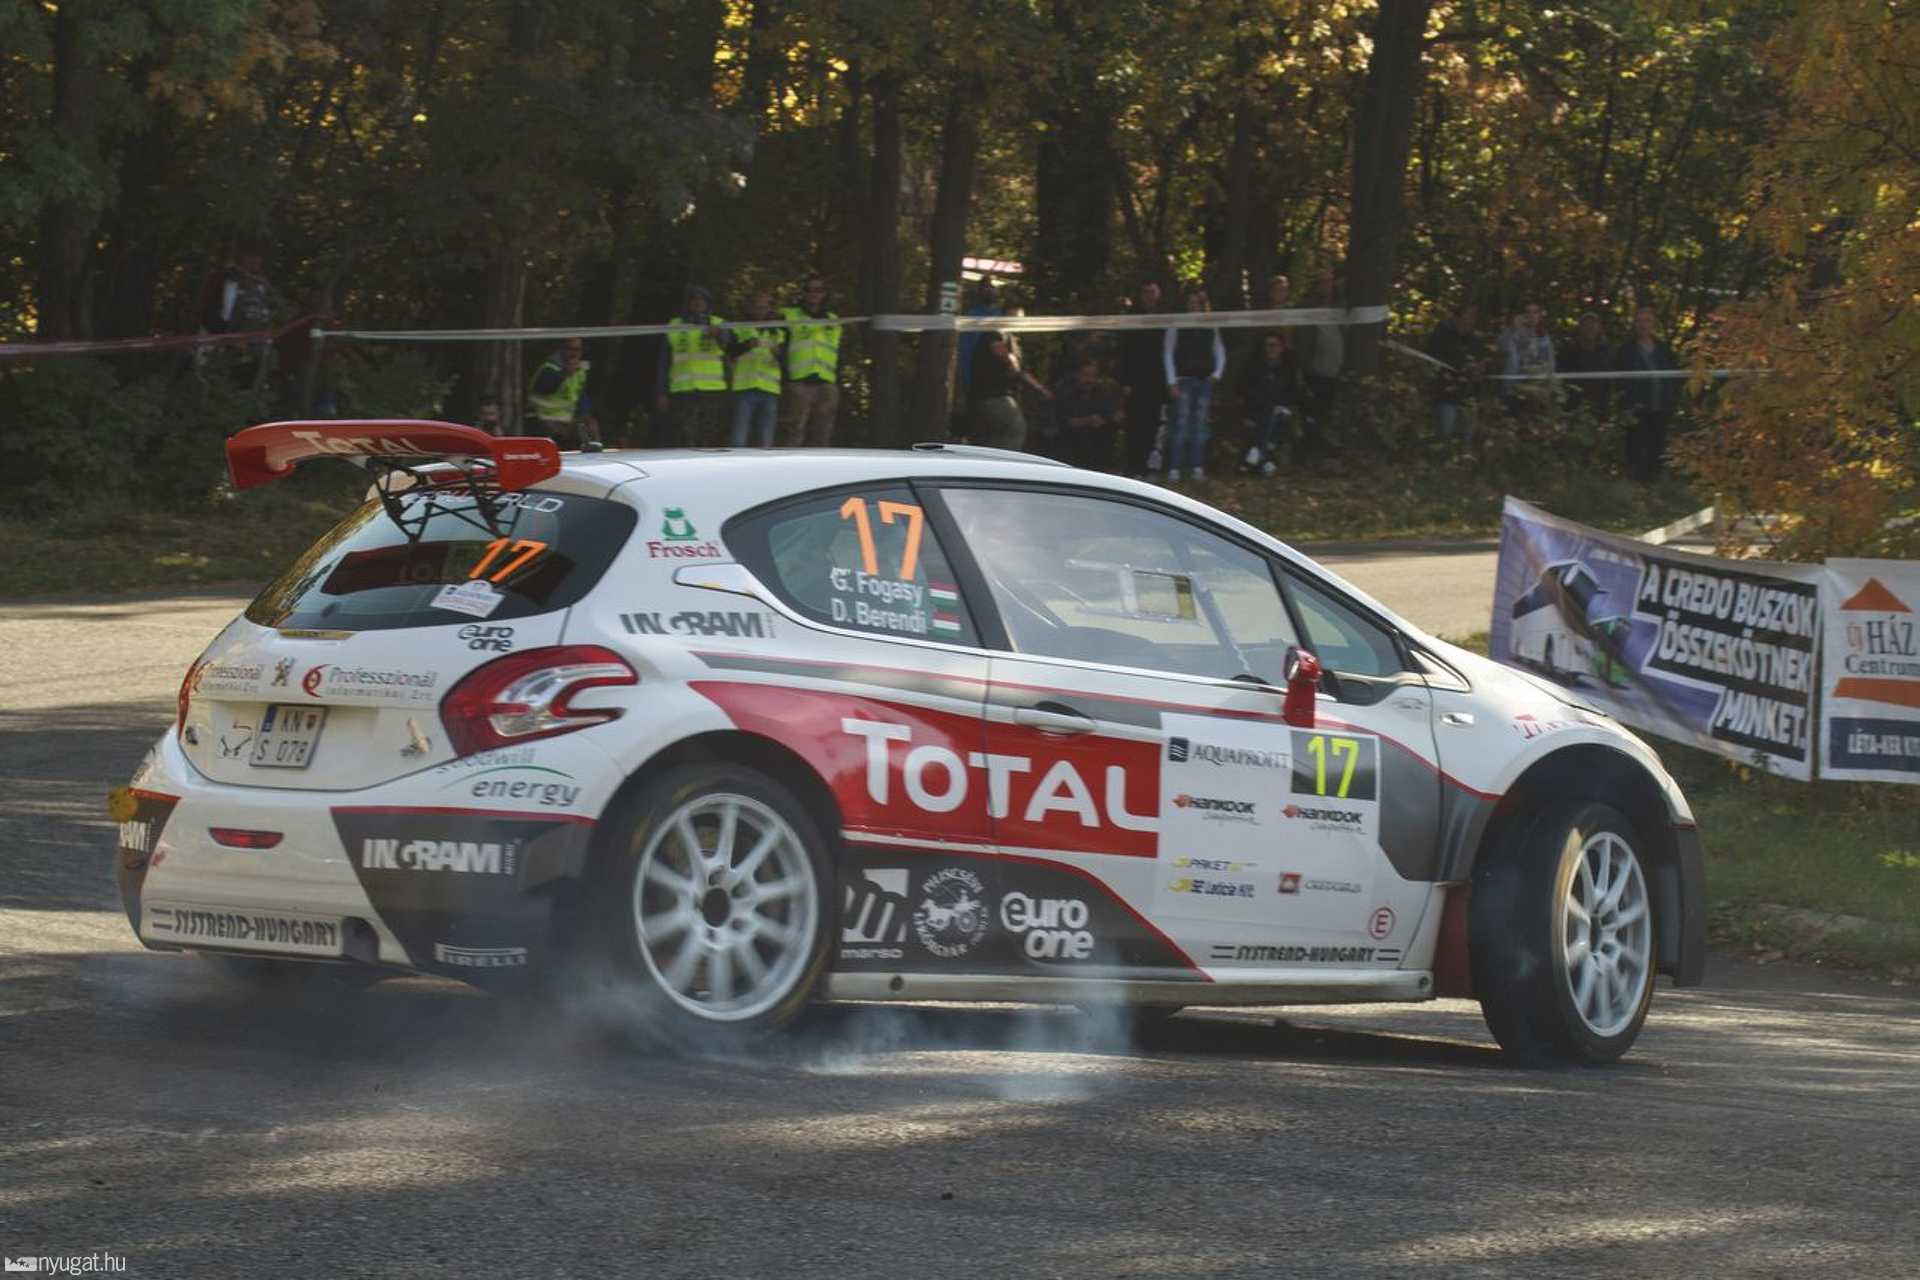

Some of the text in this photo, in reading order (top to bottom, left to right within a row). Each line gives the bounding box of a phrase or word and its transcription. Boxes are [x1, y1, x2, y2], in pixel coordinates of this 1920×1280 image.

[646, 541, 721, 558] Frosch
[840, 496, 925, 582] 17
[468, 535, 548, 583] 17
[829, 567, 924, 608] G. Fogasy
[1640, 563, 1815, 637] A CREDO BUSZOK
[457, 624, 514, 640] euro
[619, 611, 765, 638] INGRAM
[831, 598, 928, 634] D. Berendi
[469, 639, 512, 652] one
[1658, 611, 1813, 694] ÖSSZEKÖTNEK
[1866, 615, 1916, 656] HÁZ
[279, 711, 300, 733] KN
[1716, 689, 1806, 746] MINKET.
[257, 741, 309, 762] S 078
[1307, 735, 1360, 799] 17
[472, 780, 582, 807] energy
[841, 718, 1159, 832] TOTAL
[362, 838, 501, 874] INGRAM
[174, 909, 337, 947] SYSTREND-HUNGARY
[1001, 891, 1088, 933] euro
[1025, 929, 1094, 959] one
[1235, 945, 1376, 963] SYSTREND-HUNGARY
